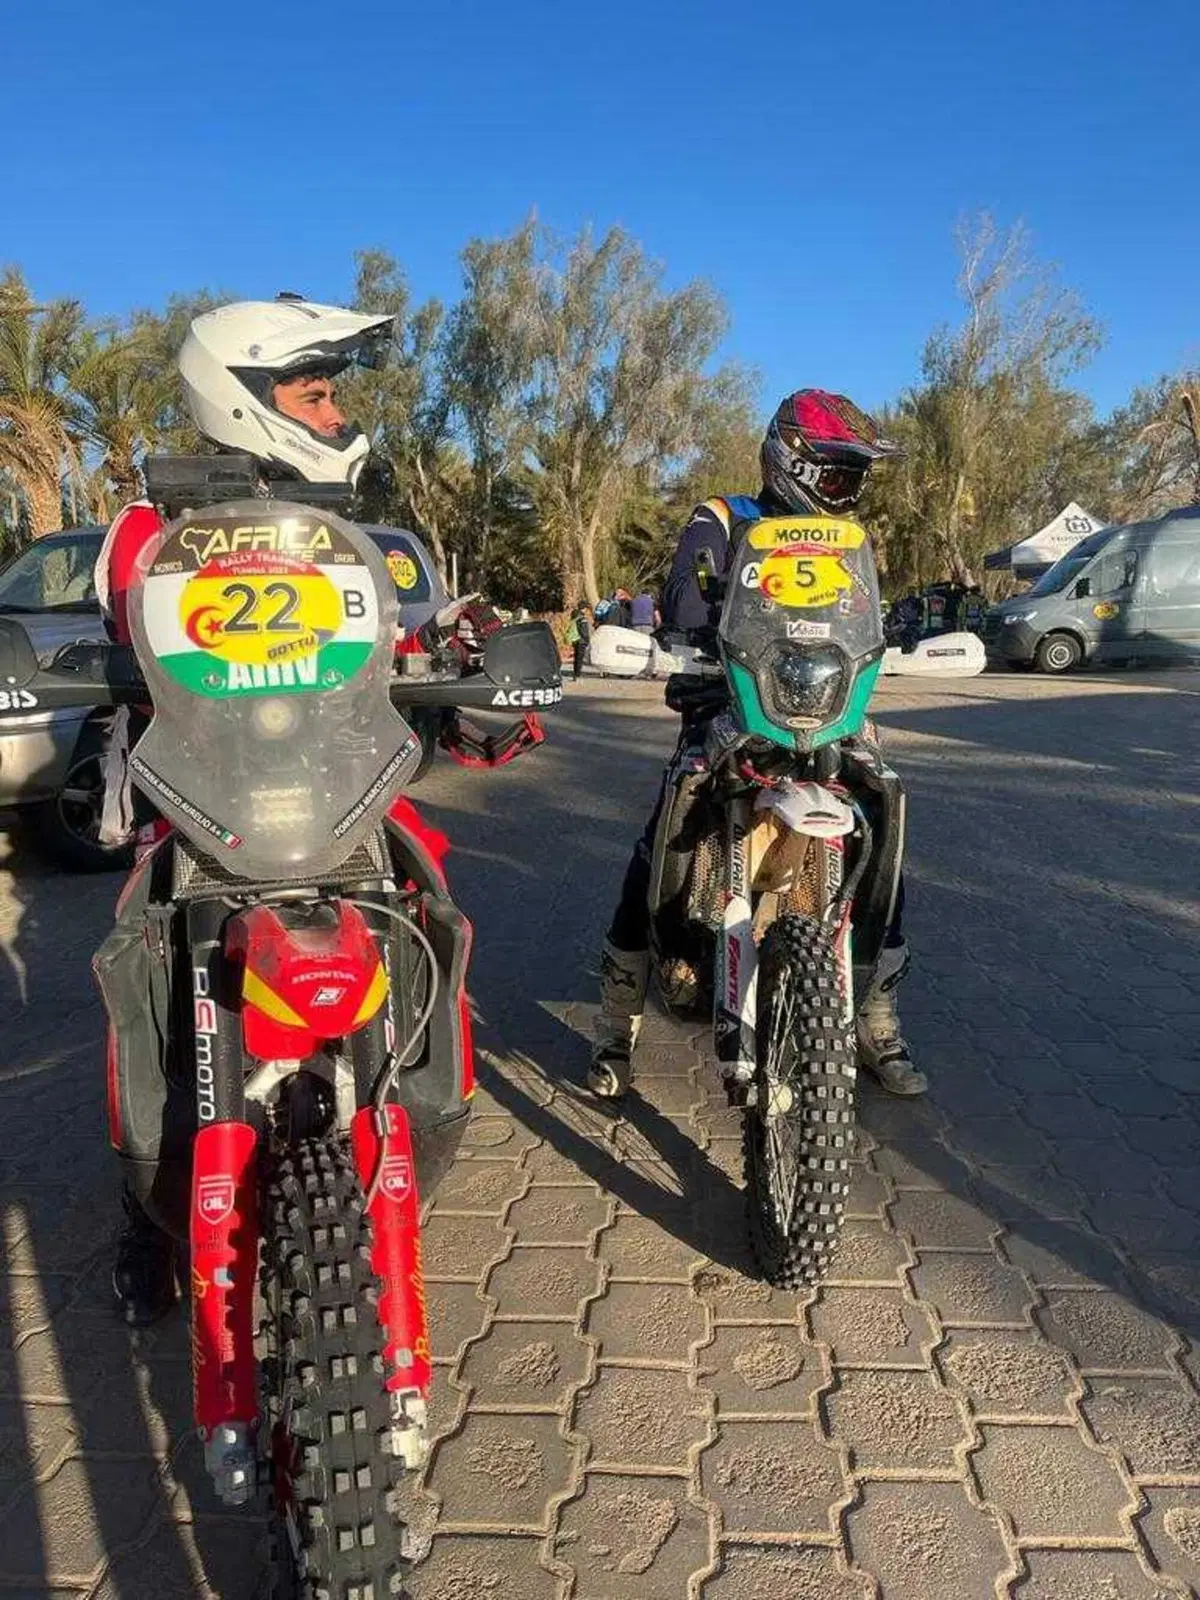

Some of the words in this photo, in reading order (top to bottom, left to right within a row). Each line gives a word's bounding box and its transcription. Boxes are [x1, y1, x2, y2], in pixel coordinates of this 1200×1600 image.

[202, 524, 332, 563] AFRICA
[774, 529, 841, 542] MOTO.IT
[747, 566, 759, 583] A
[796, 561, 816, 588] 5
[222, 582, 301, 634] 22
[344, 590, 366, 618] B
[333, 803, 367, 838] FONTANA
[292, 970, 355, 984] HONDA
[728, 936, 741, 1009] FANTIC
[384, 1176, 408, 1189] OIL
[203, 1196, 229, 1211] OIL
